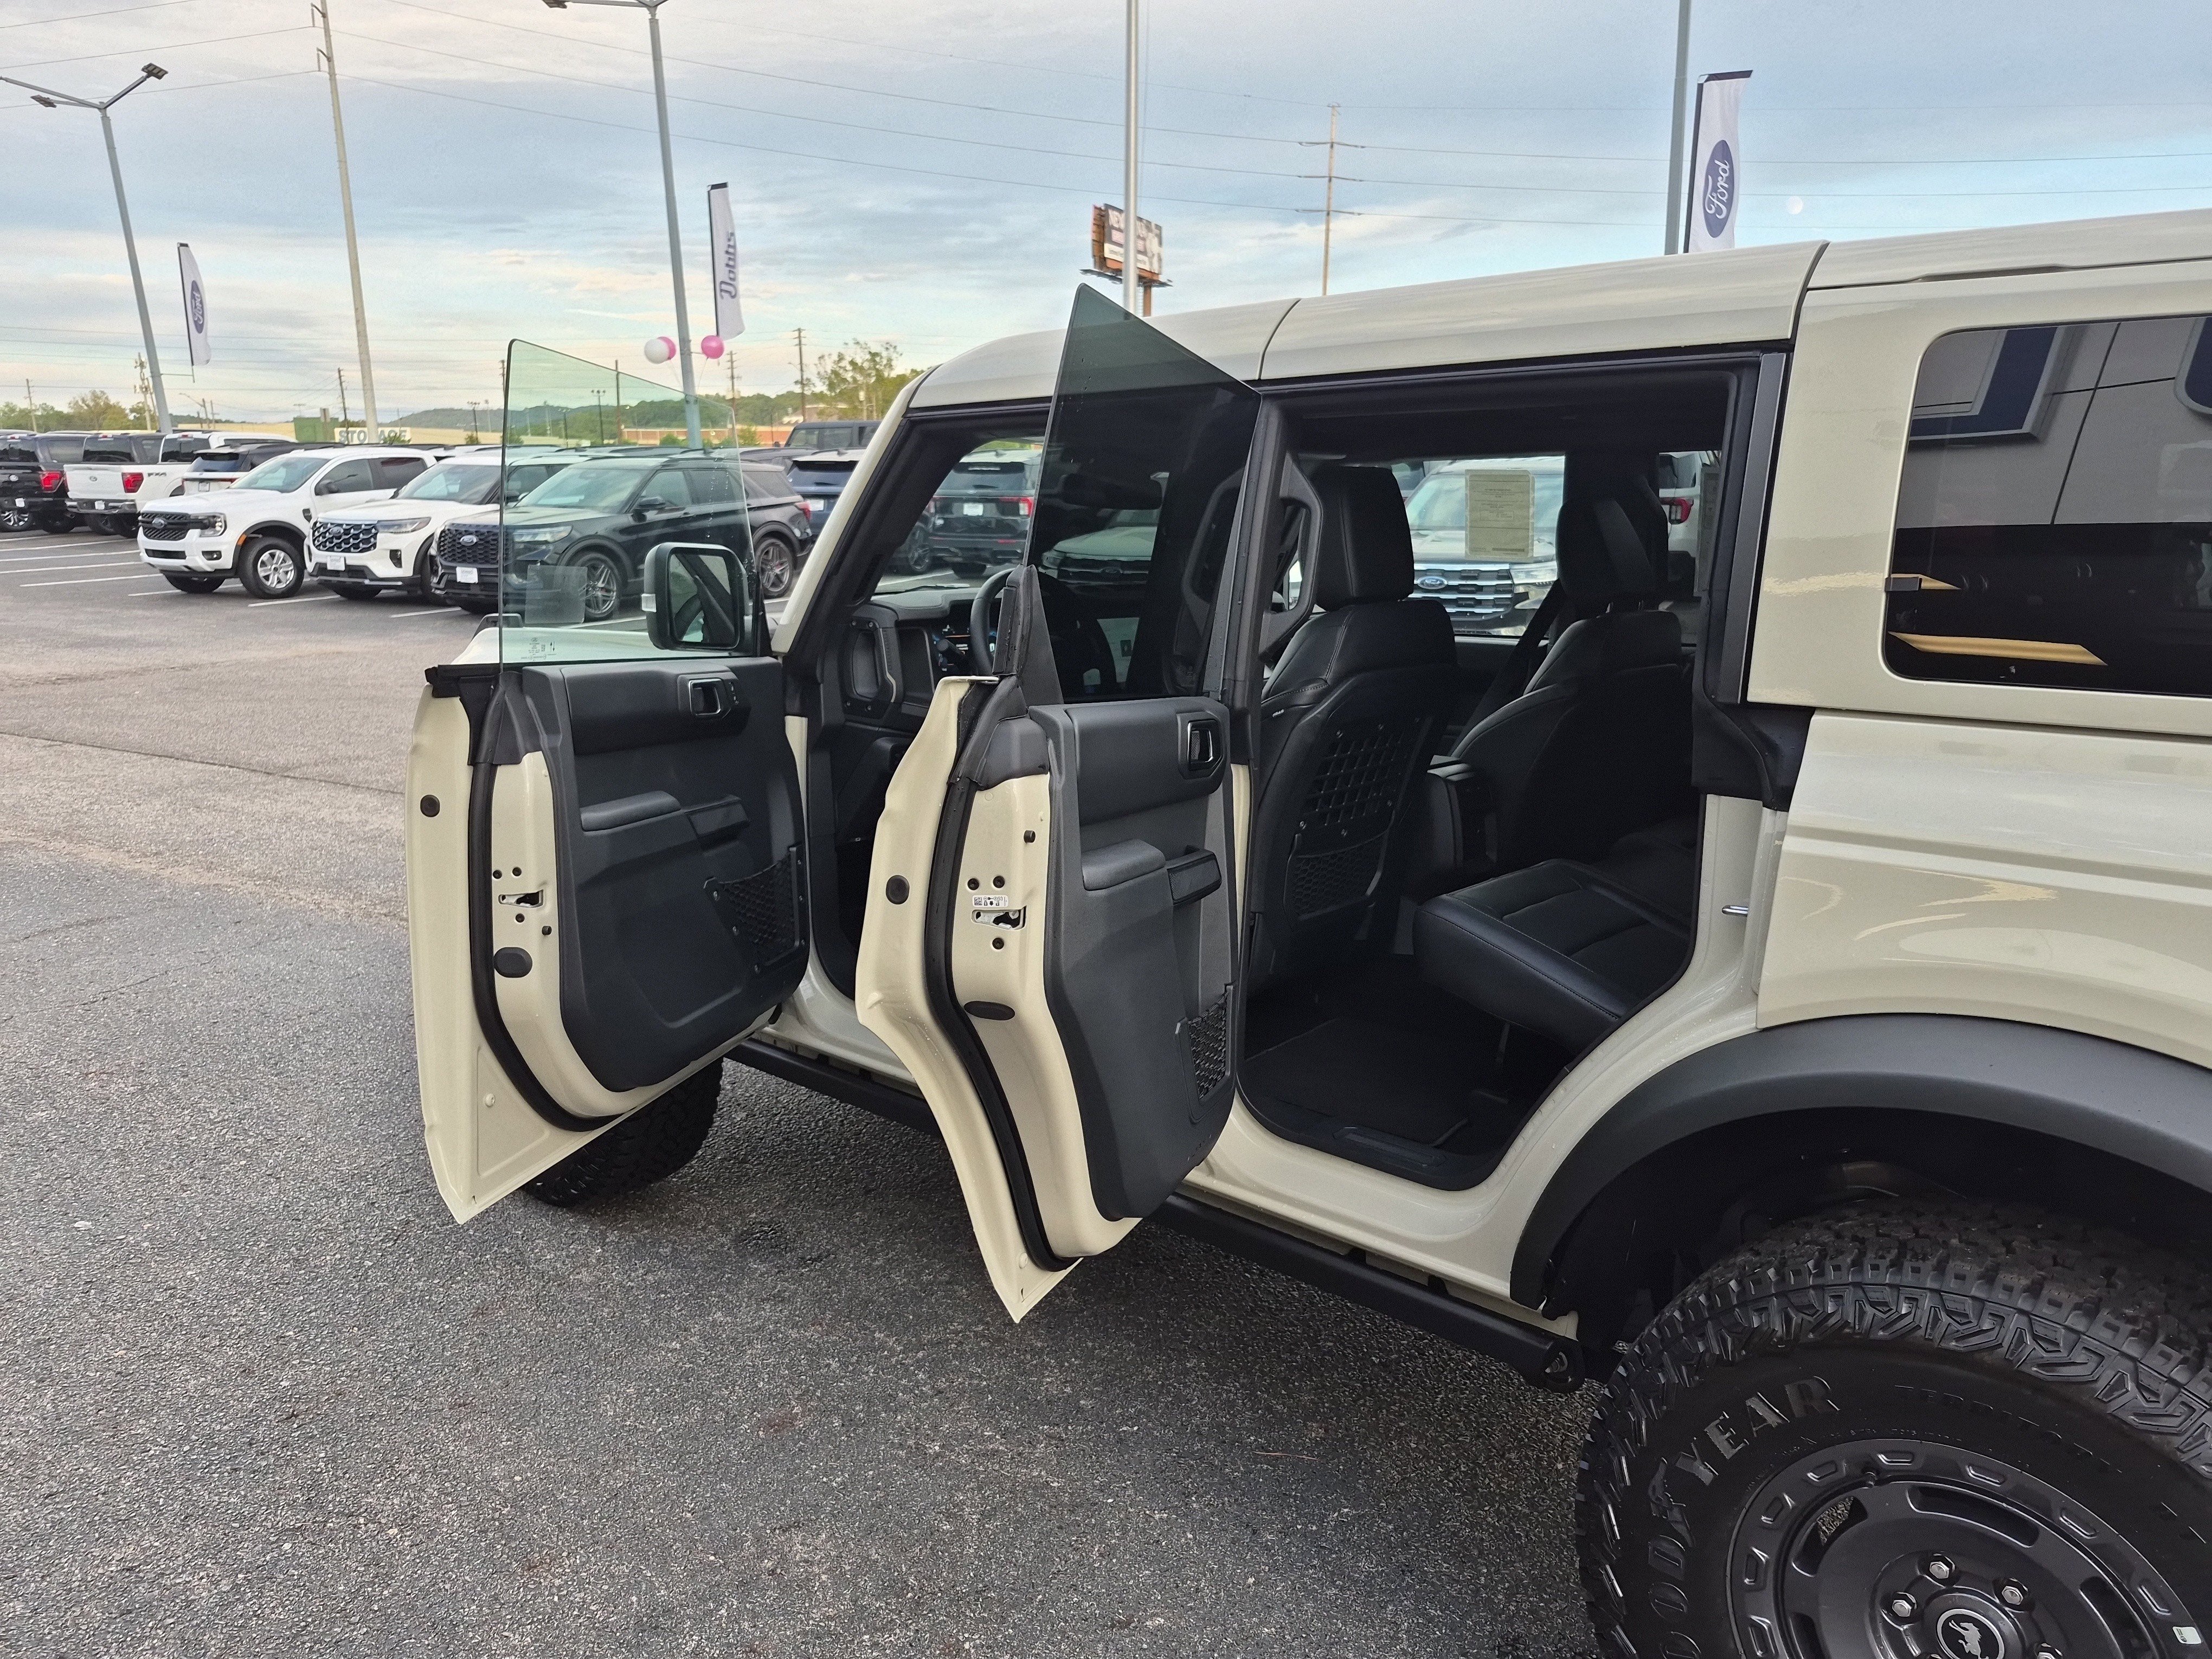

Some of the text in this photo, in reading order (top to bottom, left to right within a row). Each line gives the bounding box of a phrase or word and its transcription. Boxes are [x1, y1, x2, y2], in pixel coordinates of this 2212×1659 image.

[1705, 159, 1729, 220] Ford
[719, 231, 738, 300] Dobbs
[339, 429, 407, 444] STOAGE
[1648, 1375, 1841, 1659] OODYEAR
